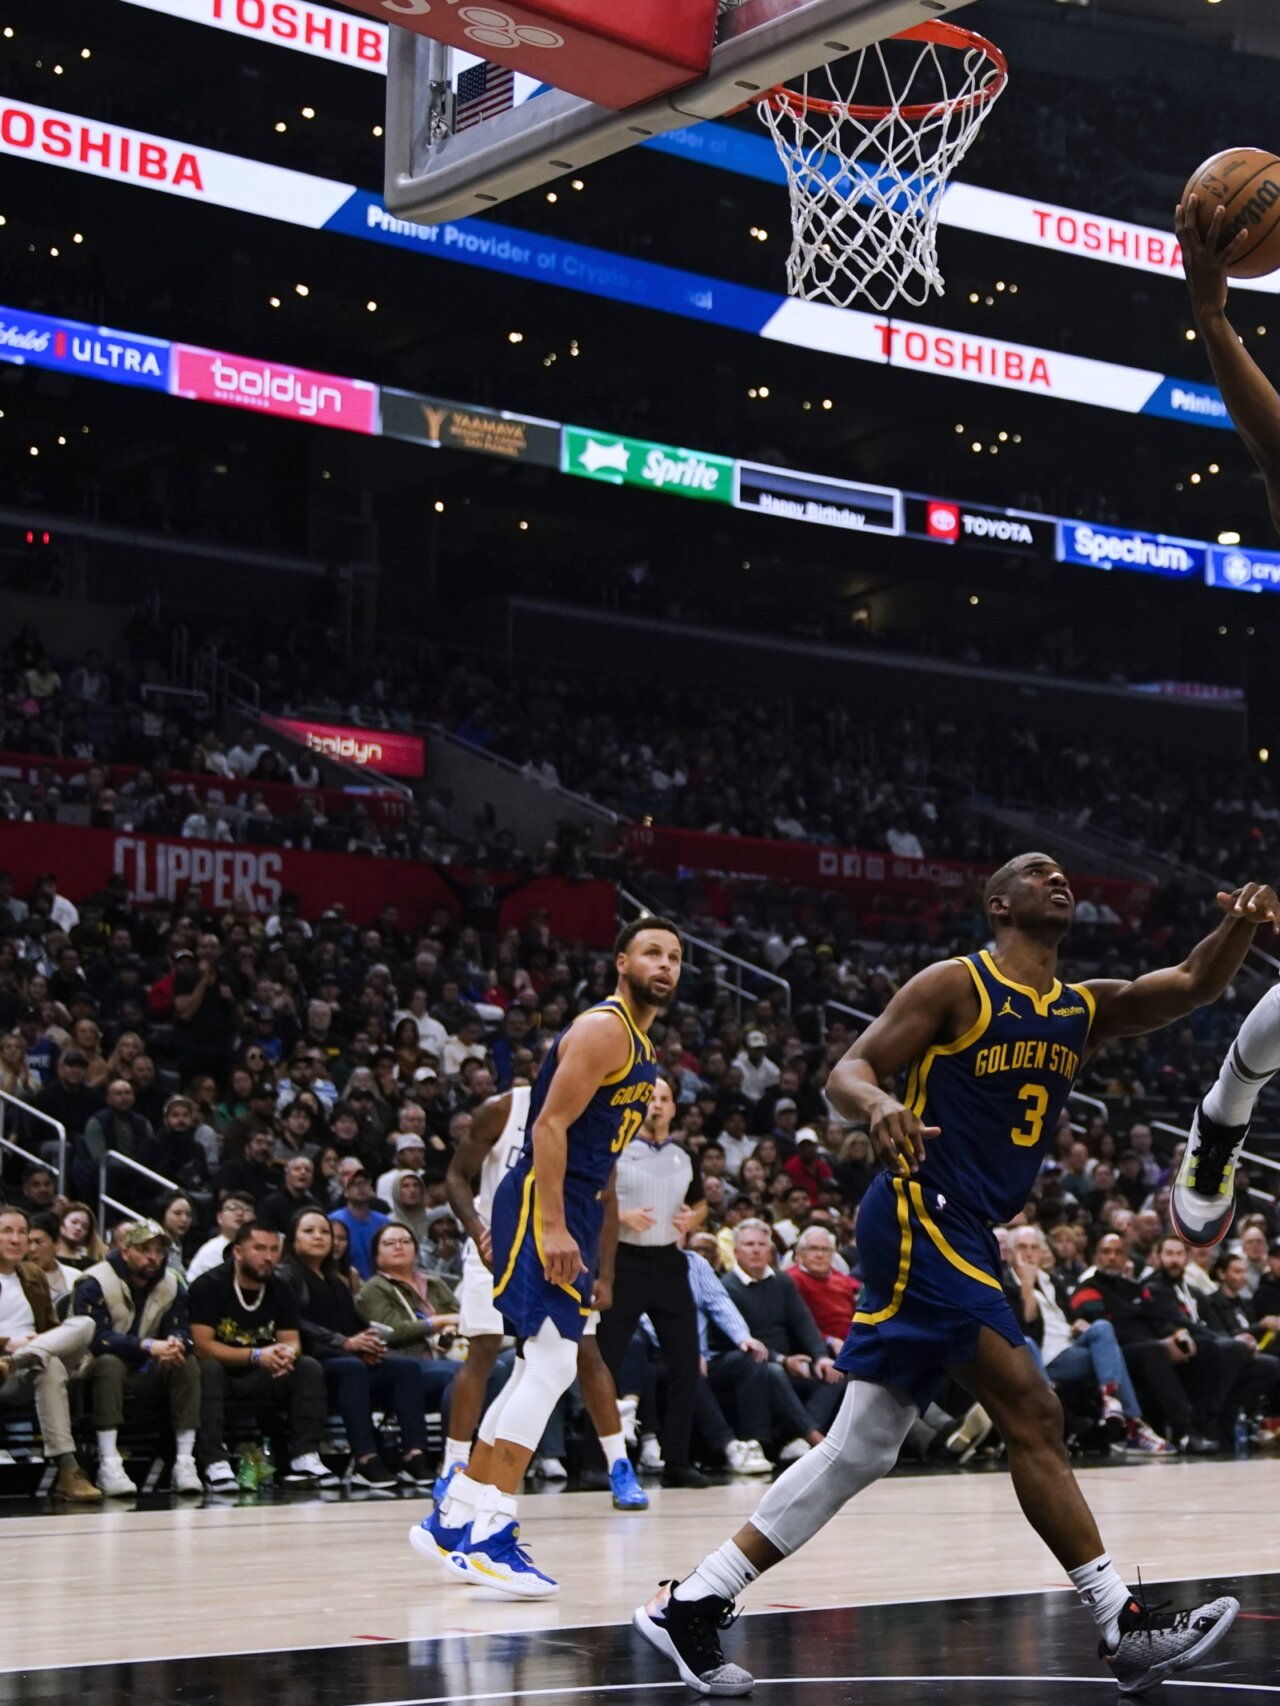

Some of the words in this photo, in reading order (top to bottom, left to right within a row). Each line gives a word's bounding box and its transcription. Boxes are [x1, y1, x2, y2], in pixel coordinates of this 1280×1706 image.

[1, 108, 204, 192] OSHIBA
[444, 223, 531, 265] Provider
[1032, 209, 1183, 268] TOSHIBA
[72, 336, 162, 377] ULTRA
[873, 323, 1052, 388] TOSHIBA
[210, 358, 342, 416] boldyn
[641, 449, 719, 491] Sprite
[759, 491, 805, 518] Happy
[806, 501, 866, 527] Birthday
[961, 513, 1034, 544] TOYOTA
[1074, 525, 1189, 572] Spectrum
[113, 836, 283, 914] CLIPPERS
[1051, 1005, 1086, 1018] Rakuten
[974, 1040, 1048, 1078] GOLDEN
[1010, 1083, 1049, 1148] 3
